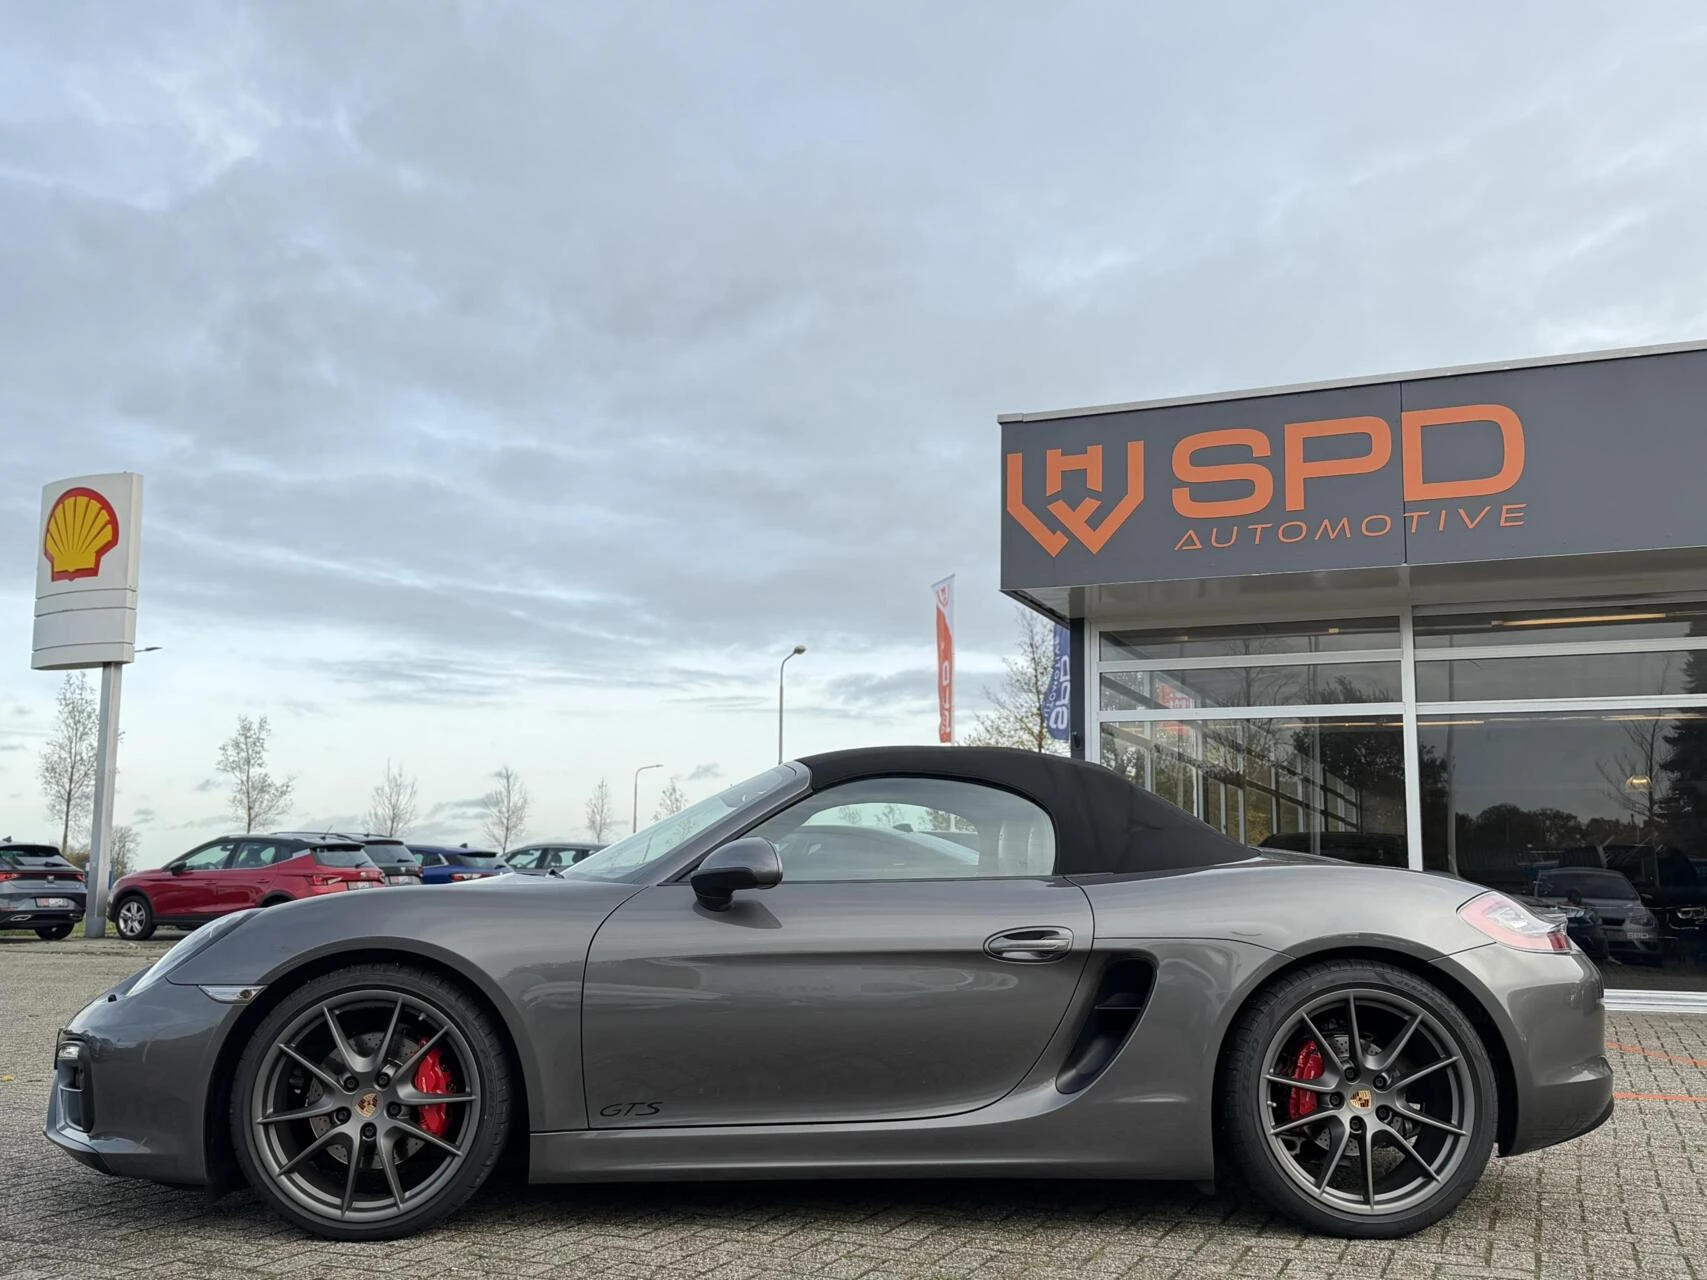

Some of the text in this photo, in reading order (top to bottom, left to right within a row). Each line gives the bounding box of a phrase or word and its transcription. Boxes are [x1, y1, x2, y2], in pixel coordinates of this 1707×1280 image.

[1172, 404, 1525, 519] SPD
[1175, 503, 1528, 551] AUTOMOTIVE
[600, 1101, 664, 1117] GTS
